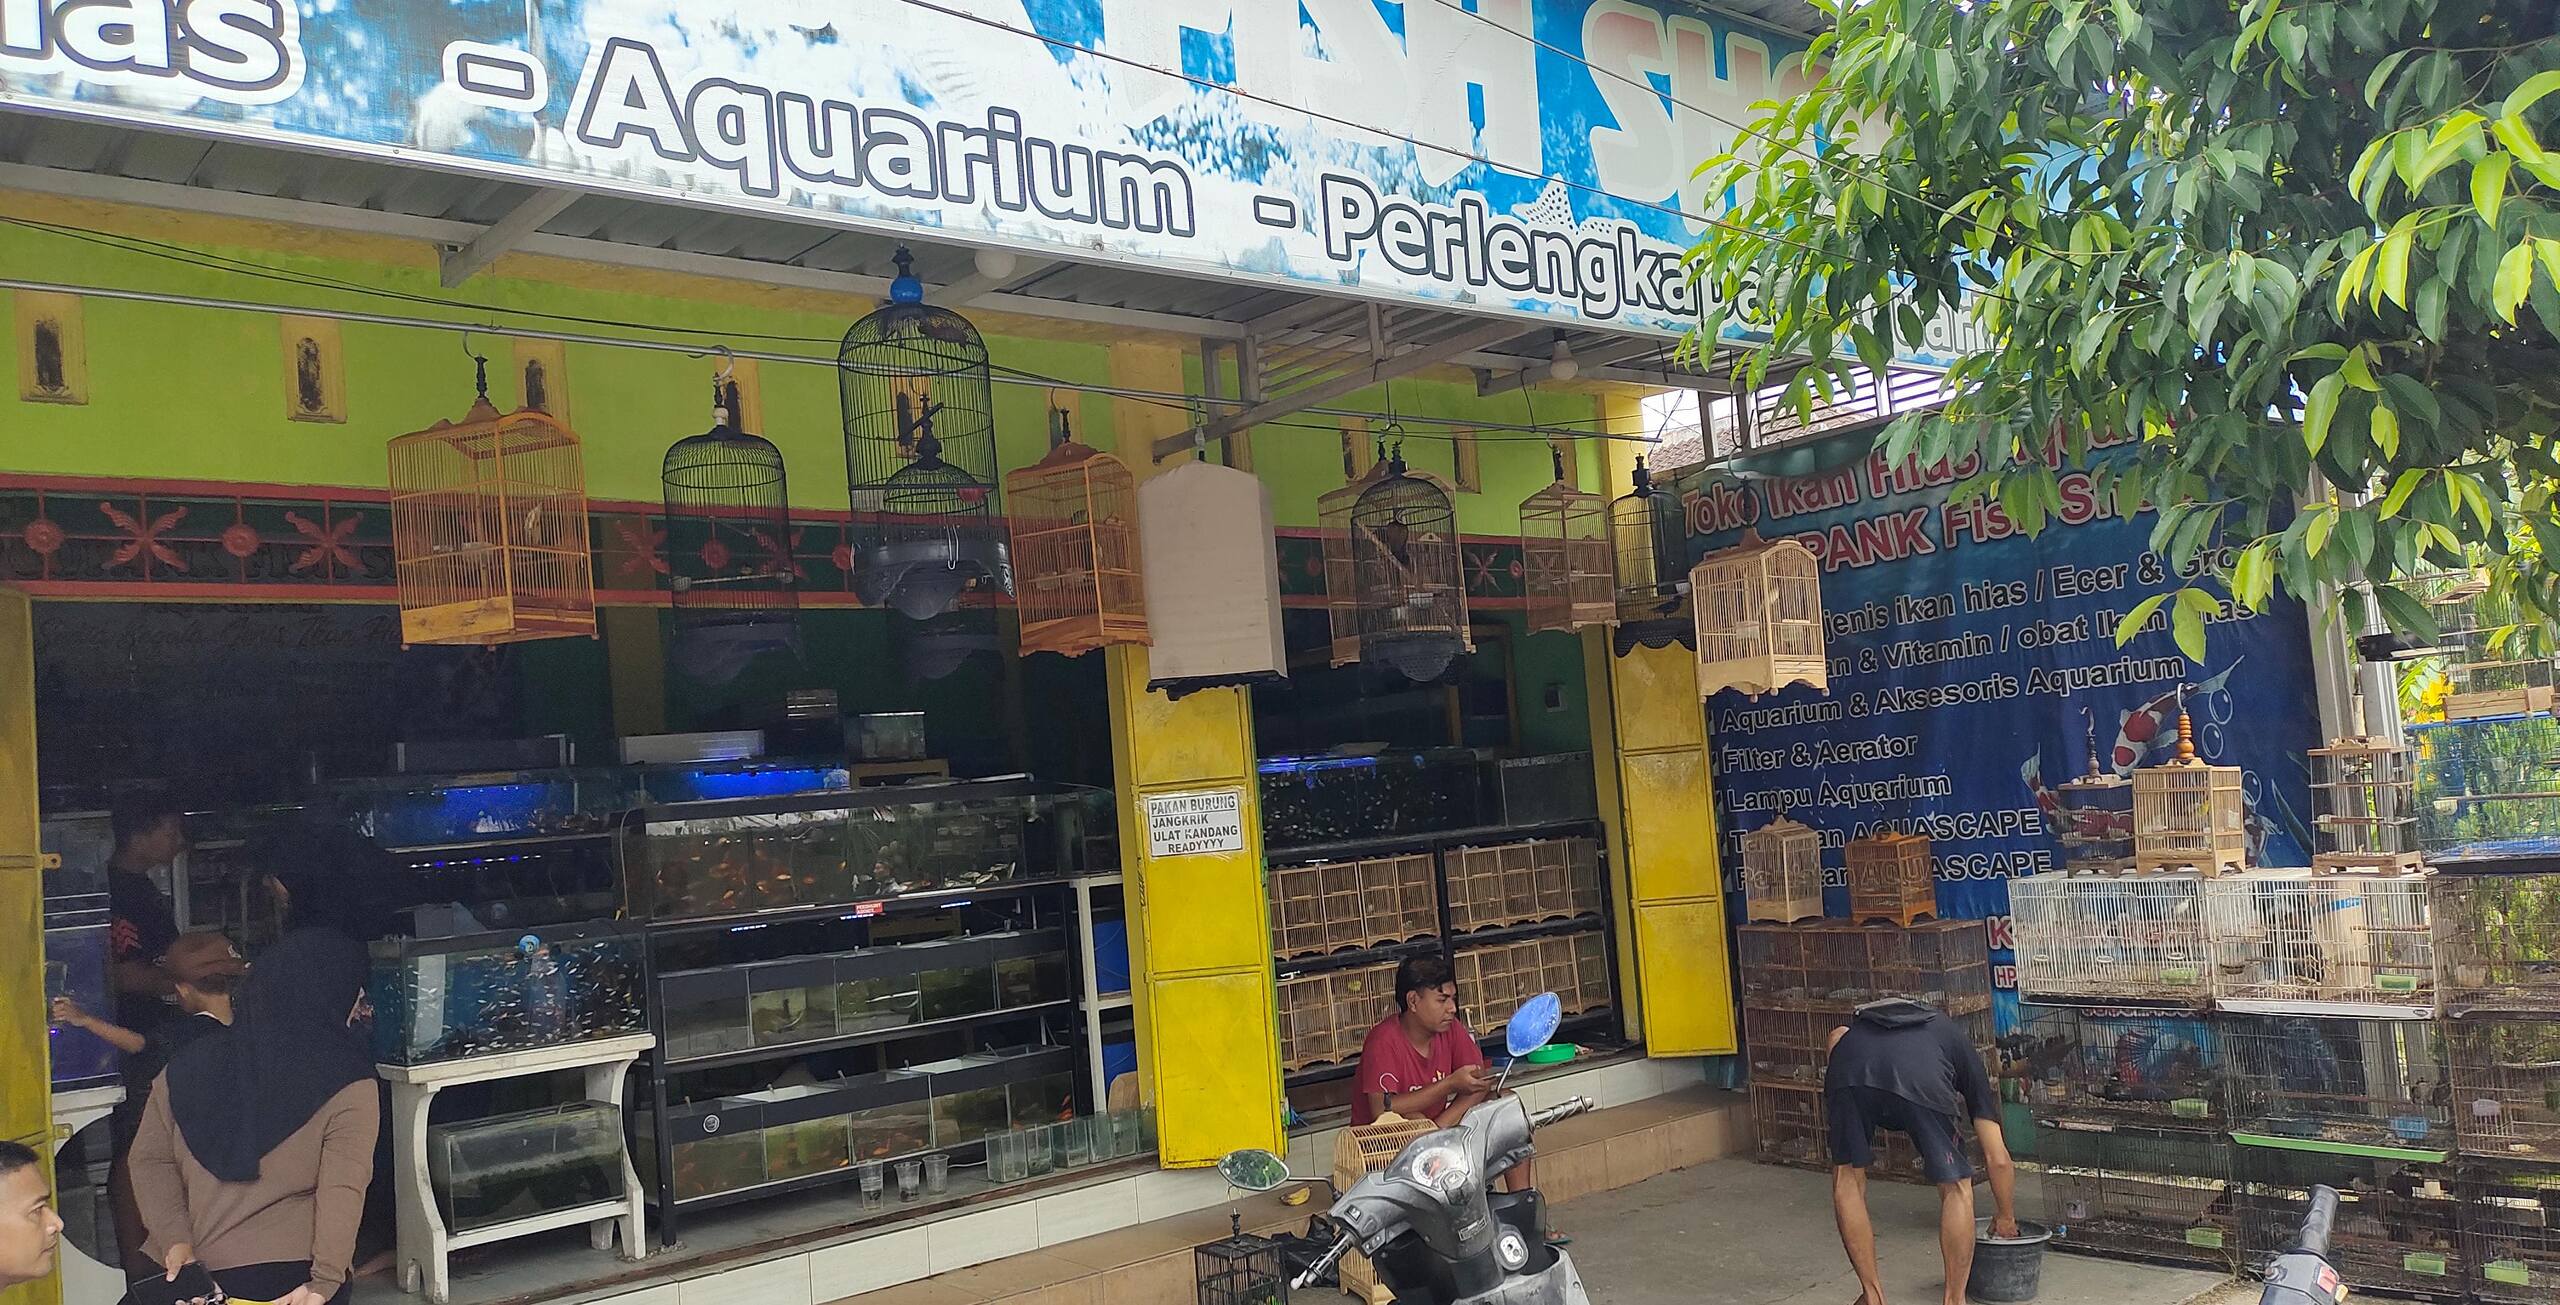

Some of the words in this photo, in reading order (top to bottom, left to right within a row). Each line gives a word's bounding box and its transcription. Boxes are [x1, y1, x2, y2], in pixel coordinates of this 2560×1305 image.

[577, 37, 1195, 238] Aquarium
[1682, 481, 1760, 538] Toko
[1765, 466, 1859, 520] Ikan
[1942, 484, 2046, 549] Fis
[1824, 602, 1890, 643] jenis
[1895, 594, 1956, 625] ikan
[1963, 578, 2028, 613] hias
[2051, 563, 2128, 598] Ecer
[2137, 551, 2166, 585] &
[1858, 647, 1879, 675] &
[1881, 630, 1993, 670] Vitamin
[2018, 614, 2090, 650] obat
[1721, 700, 1842, 734] Aquarium
[1849, 692, 1870, 718] &
[1874, 672, 2018, 716] Aksesoris
[2026, 655, 2186, 704] Aquarium
[1723, 747, 1785, 774] Filter
[1791, 742, 1812, 768] &
[1816, 733, 1918, 766] Aerator
[1151, 799, 1187, 815] PAKAN
[1190, 795, 1236, 812] BURUNG
[1727, 786, 1813, 814] Lampu
[1817, 773, 1953, 809] Aquarium
[1152, 813, 1209, 829] JANGKRIK
[1153, 829, 1181, 842] ULAT
[1185, 825, 1238, 840] KANDANG
[1168, 838, 1225, 853] READYYYY
